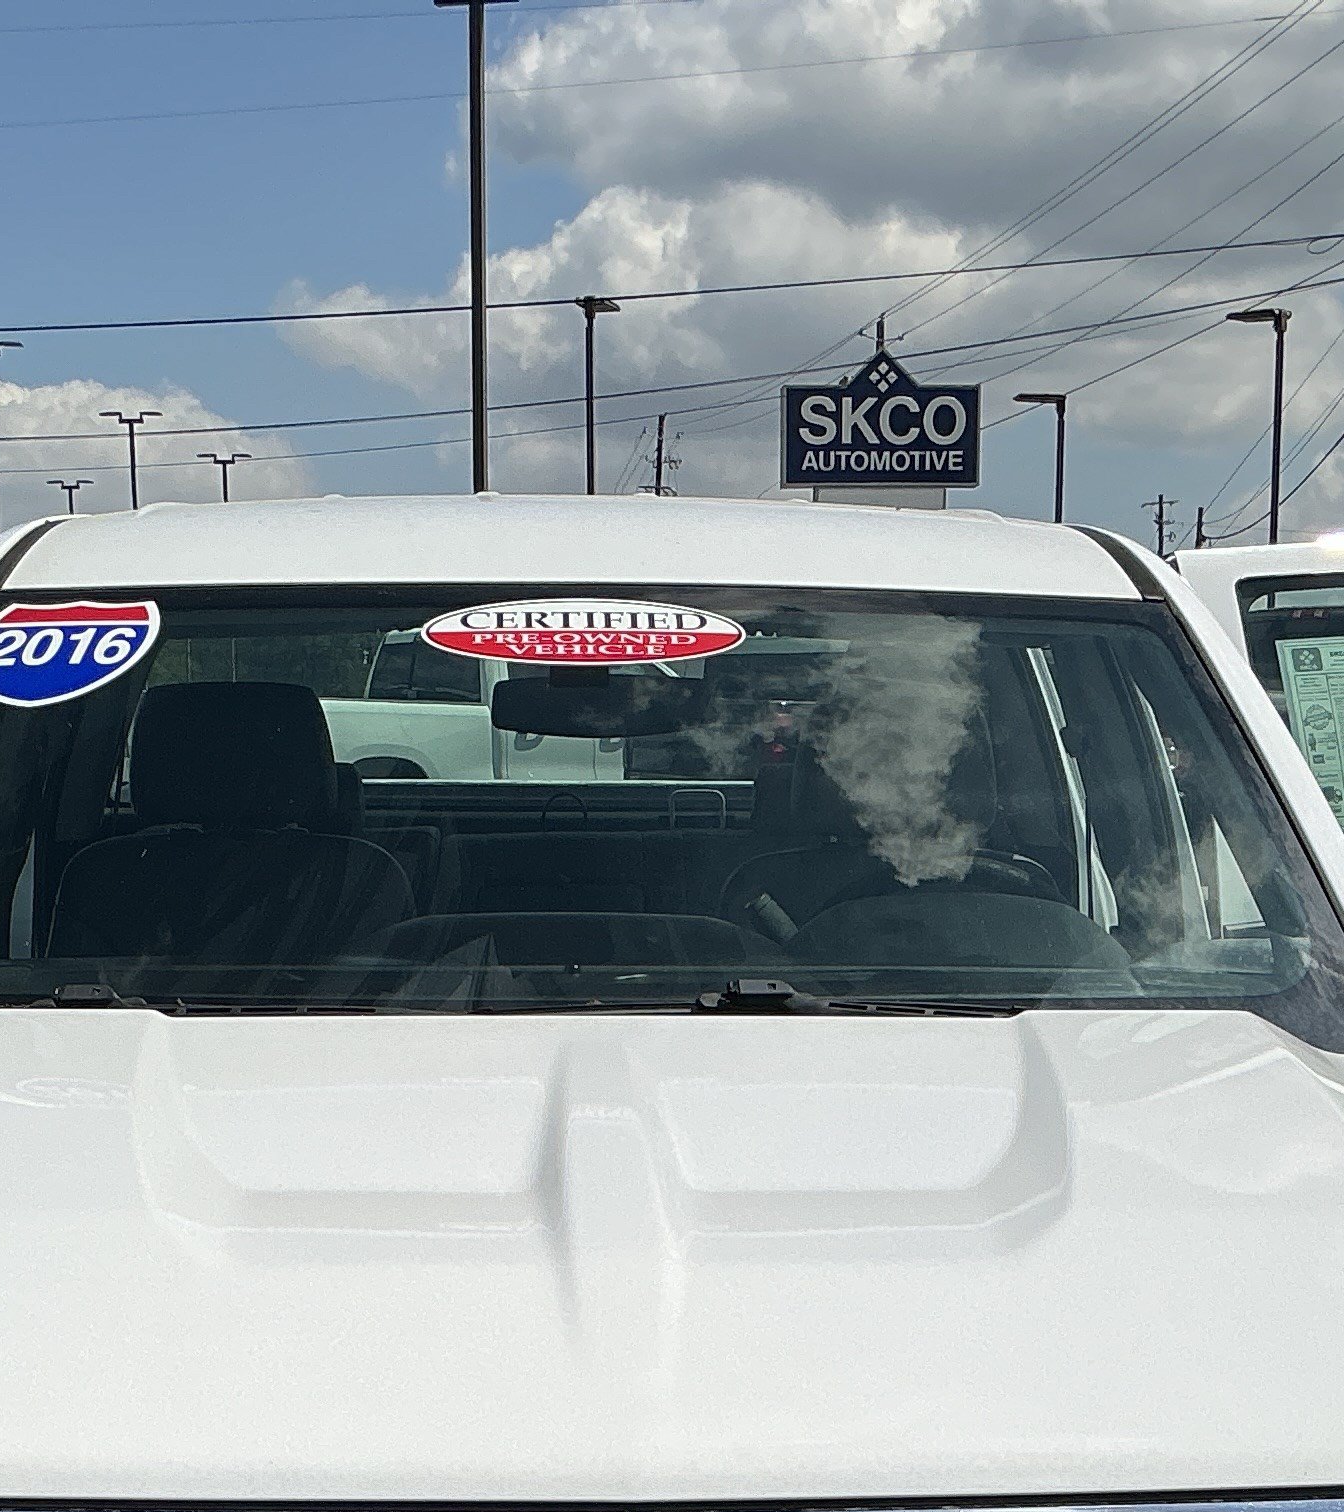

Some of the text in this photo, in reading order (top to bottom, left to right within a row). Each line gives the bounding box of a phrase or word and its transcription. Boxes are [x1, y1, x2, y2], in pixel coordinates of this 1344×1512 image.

[798, 395, 967, 446] SKCO
[801, 450, 964, 472] AUTOMOTIVE
[460, 611, 707, 630] CERTIFIED
[472, 633, 697, 645] PRE-OWNED
[506, 644, 666, 656] VEHICLE
